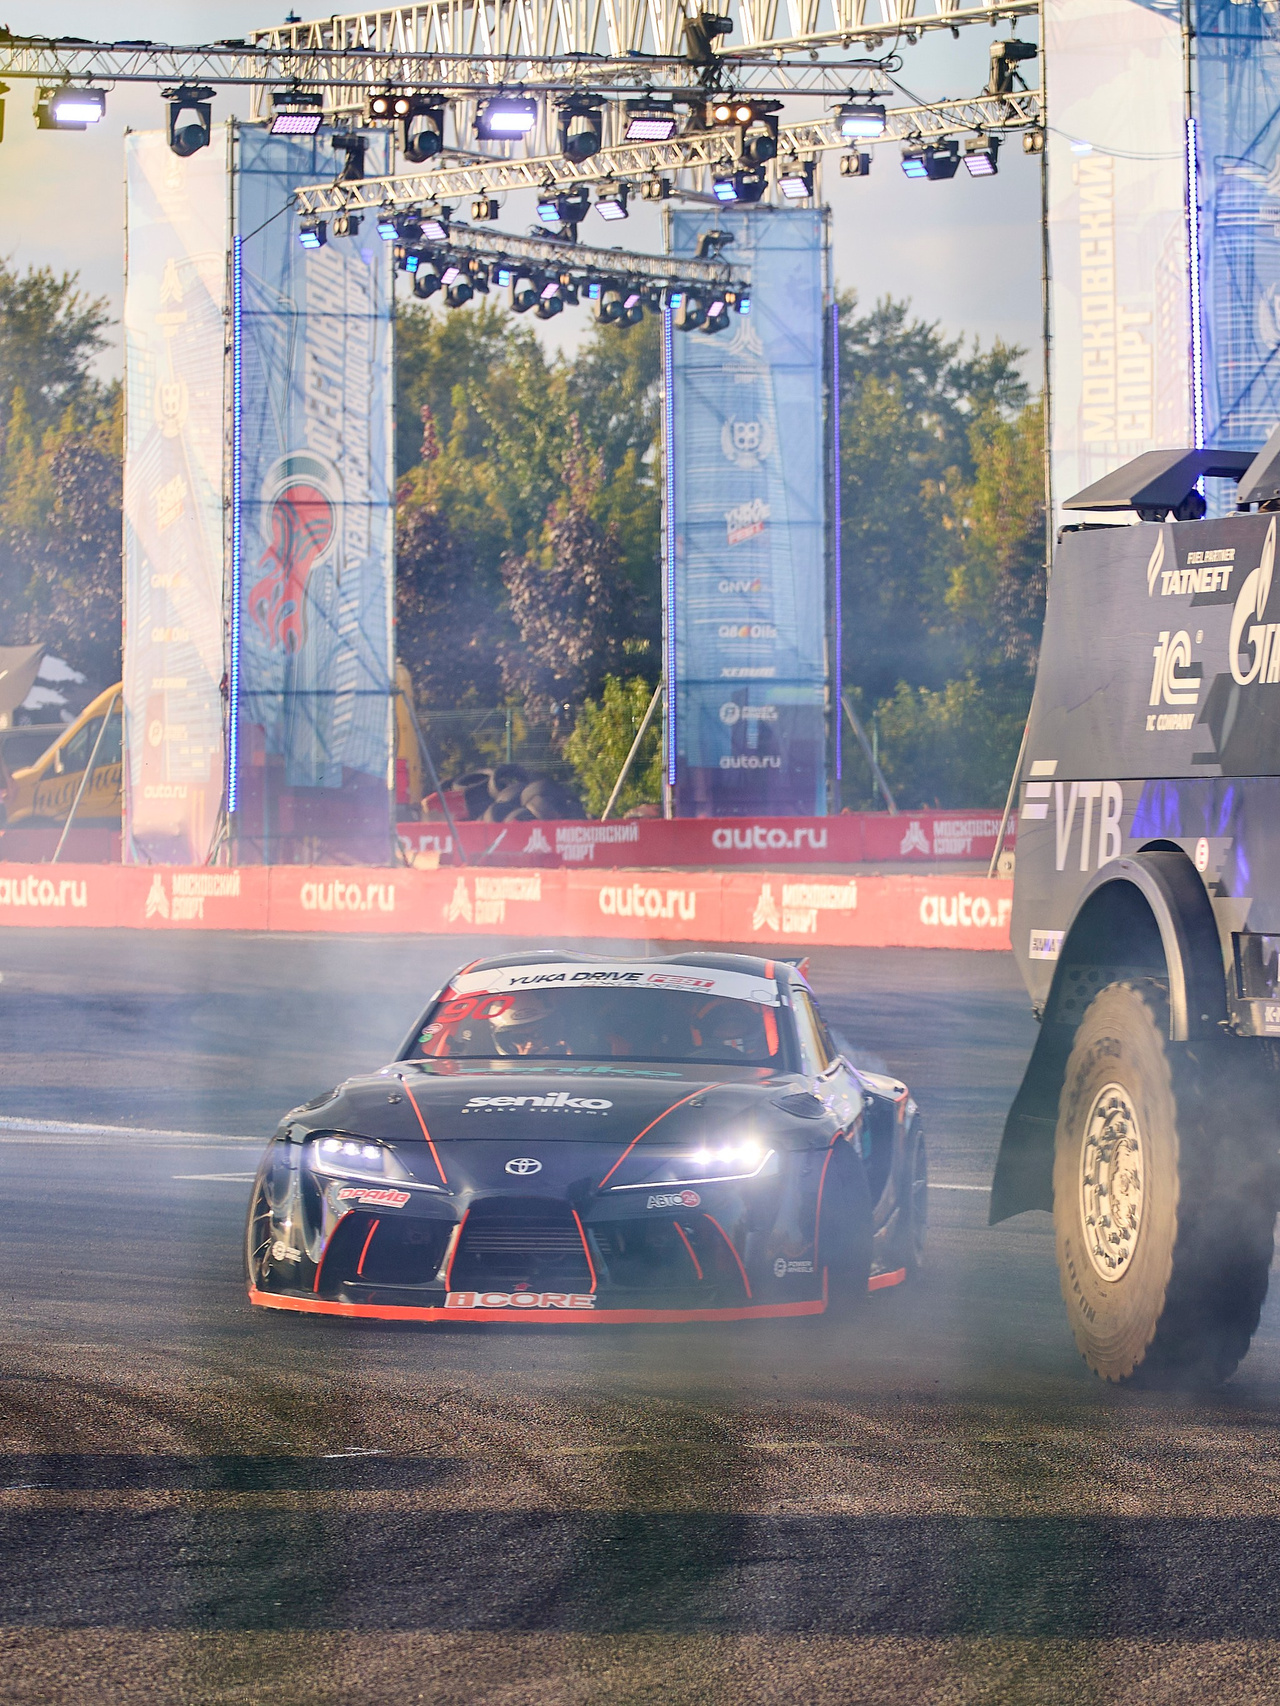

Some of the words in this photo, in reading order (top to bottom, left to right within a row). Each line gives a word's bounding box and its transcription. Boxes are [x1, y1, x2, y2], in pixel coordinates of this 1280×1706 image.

[1072, 155, 1116, 442] МОСКОВСКИЙ
[304, 248, 345, 461] ФЕСТИВАЛЬ
[1115, 305, 1153, 442] СПОРТ
[1161, 566, 1234, 595] TATNEFT
[719, 754, 781, 769] auto.ru
[143, 783, 188, 798] auto.ru
[556, 822, 640, 843] МОСКОВСКИЙ
[712, 824, 828, 850] auto.ru
[1055, 782, 1124, 872] VTB
[300, 879, 395, 912] auto.ru
[599, 883, 696, 920] auto.ru
[509, 972, 567, 986] YUKA
[571, 971, 644, 982] DRIVE
[650, 974, 715, 988] FEST
[435, 995, 516, 1024] 90
[465, 1092, 614, 1111] seniko
